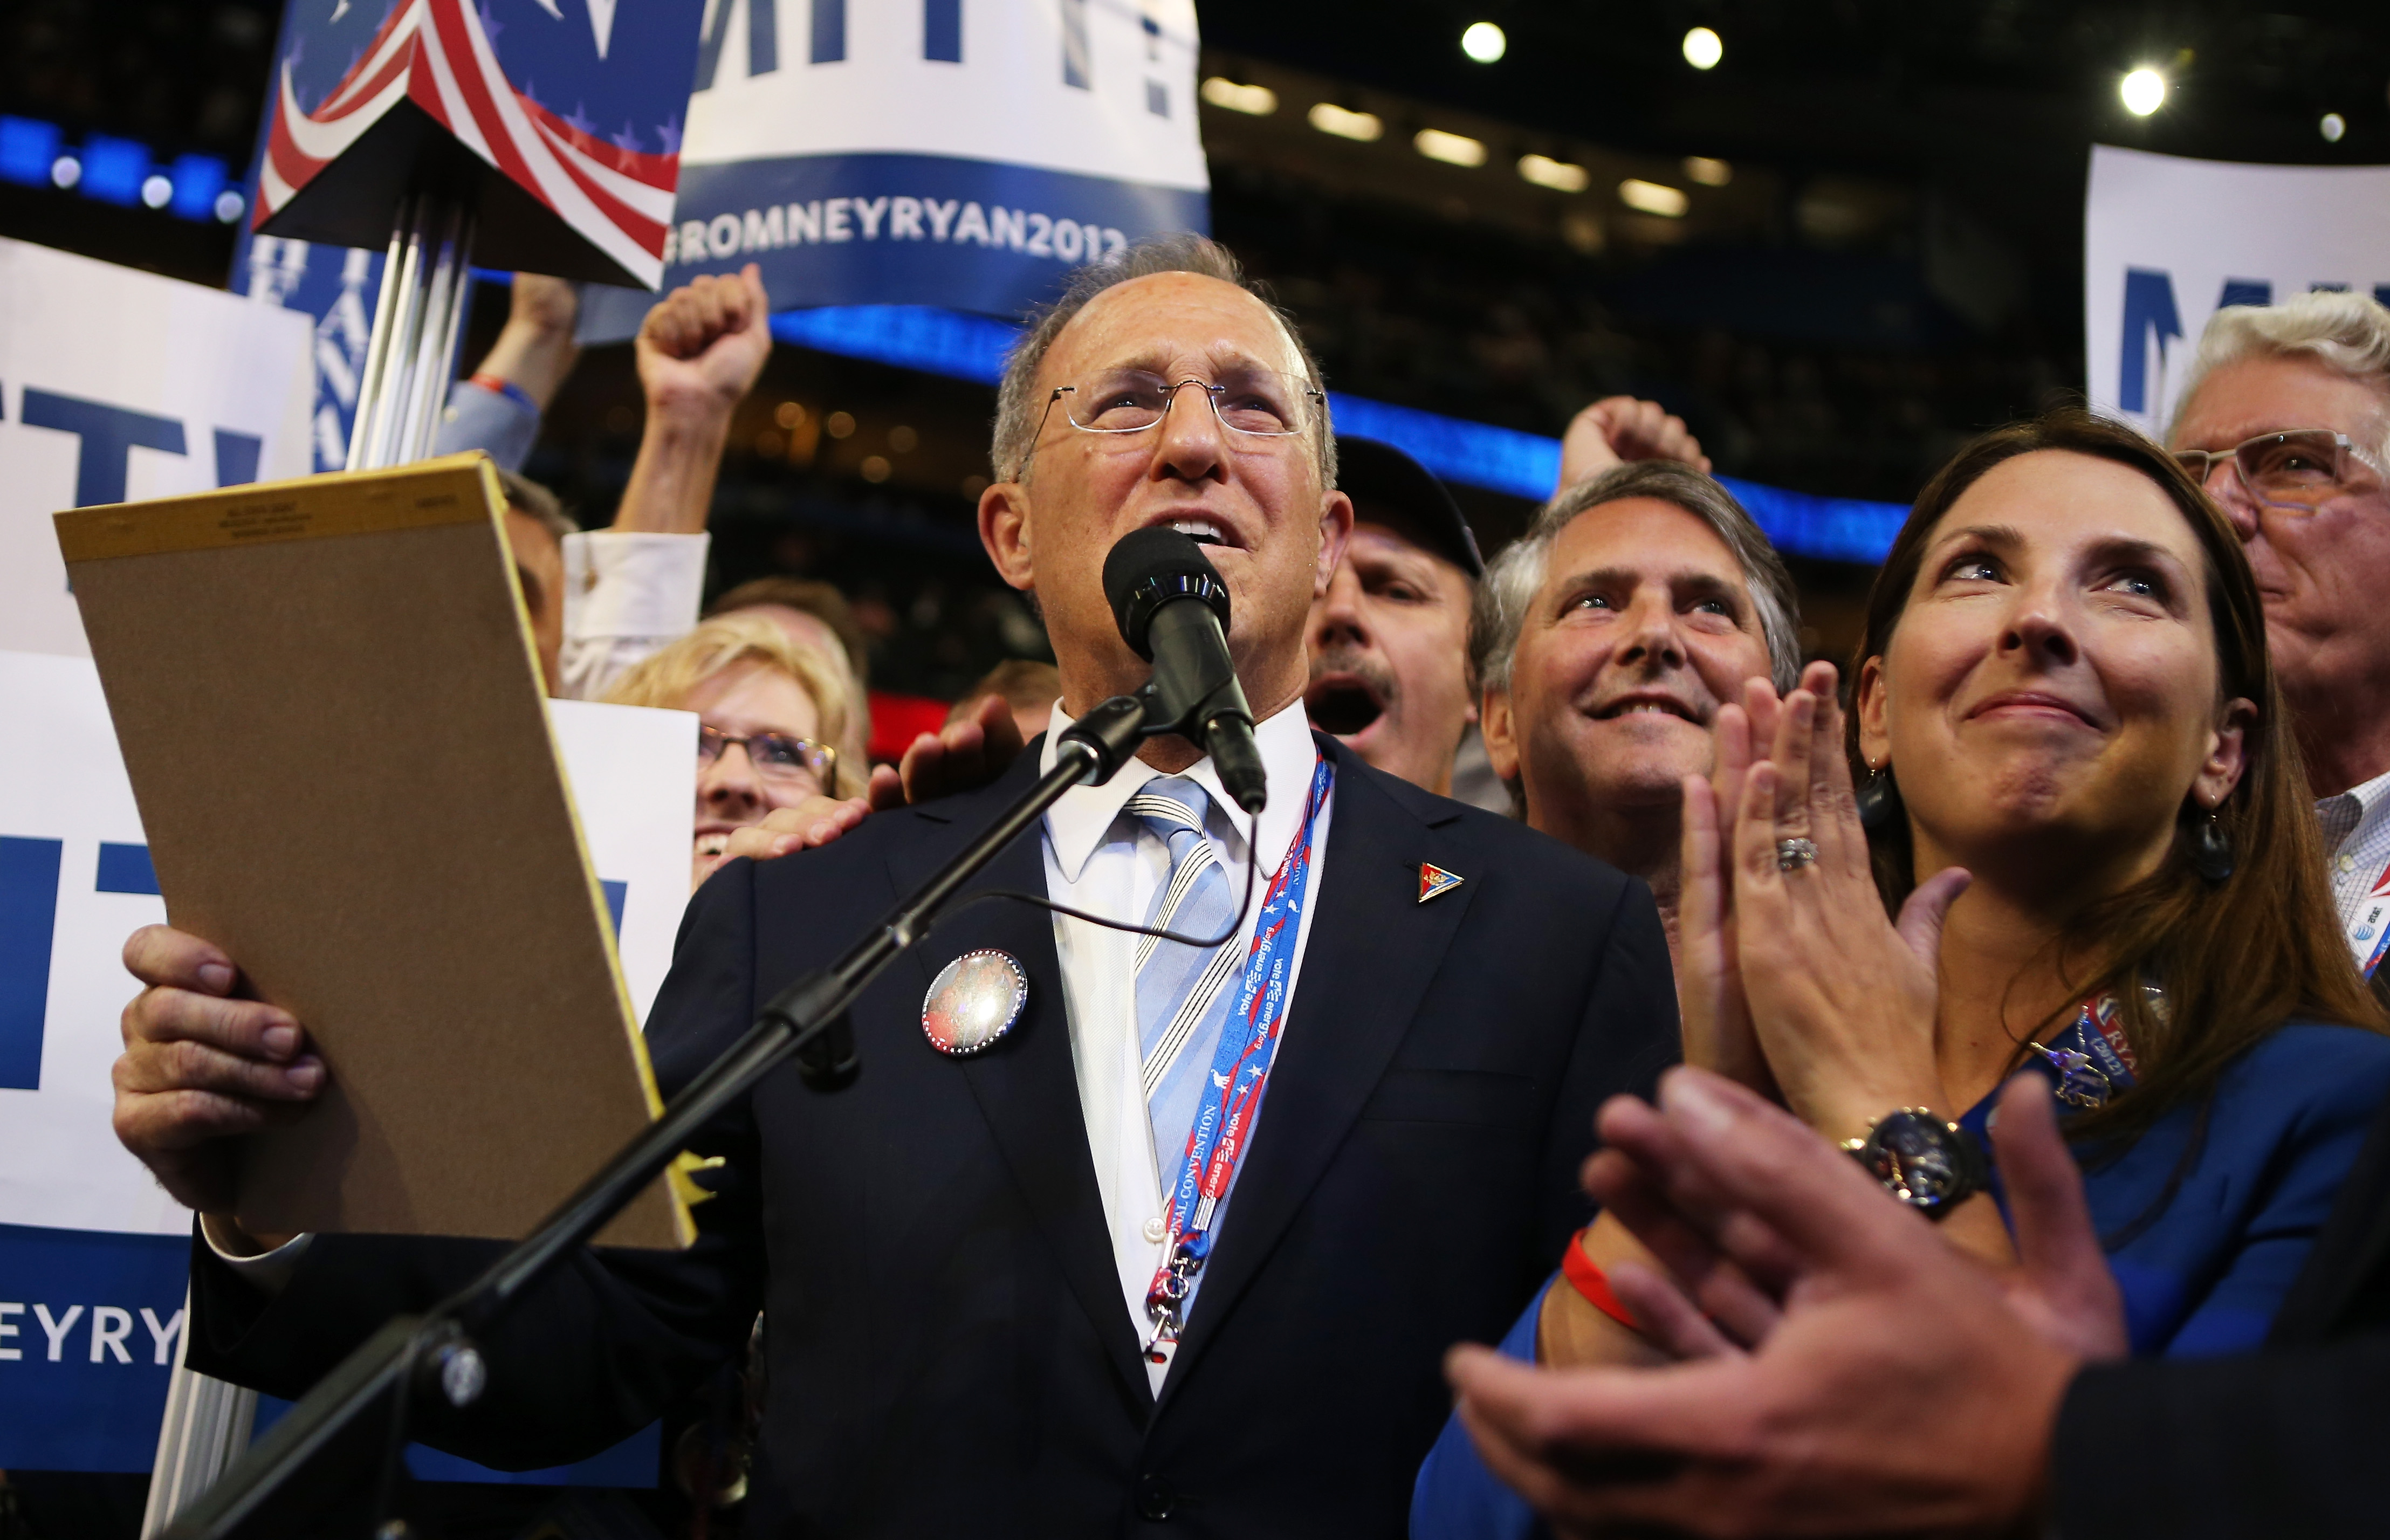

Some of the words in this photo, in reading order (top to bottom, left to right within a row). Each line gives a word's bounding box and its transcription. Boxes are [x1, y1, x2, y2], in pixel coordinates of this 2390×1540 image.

[1238, 993, 1253, 1016] vote
[1255, 926, 1274, 972] energy.org
[1272, 958, 1283, 979] vote
[1254, 1001, 1274, 1049] energy.org
[2106, 1030, 2139, 1075] RYA
[1226, 1112, 1242, 1137] vote
[1180, 1104, 1217, 1199] CONVENTION
